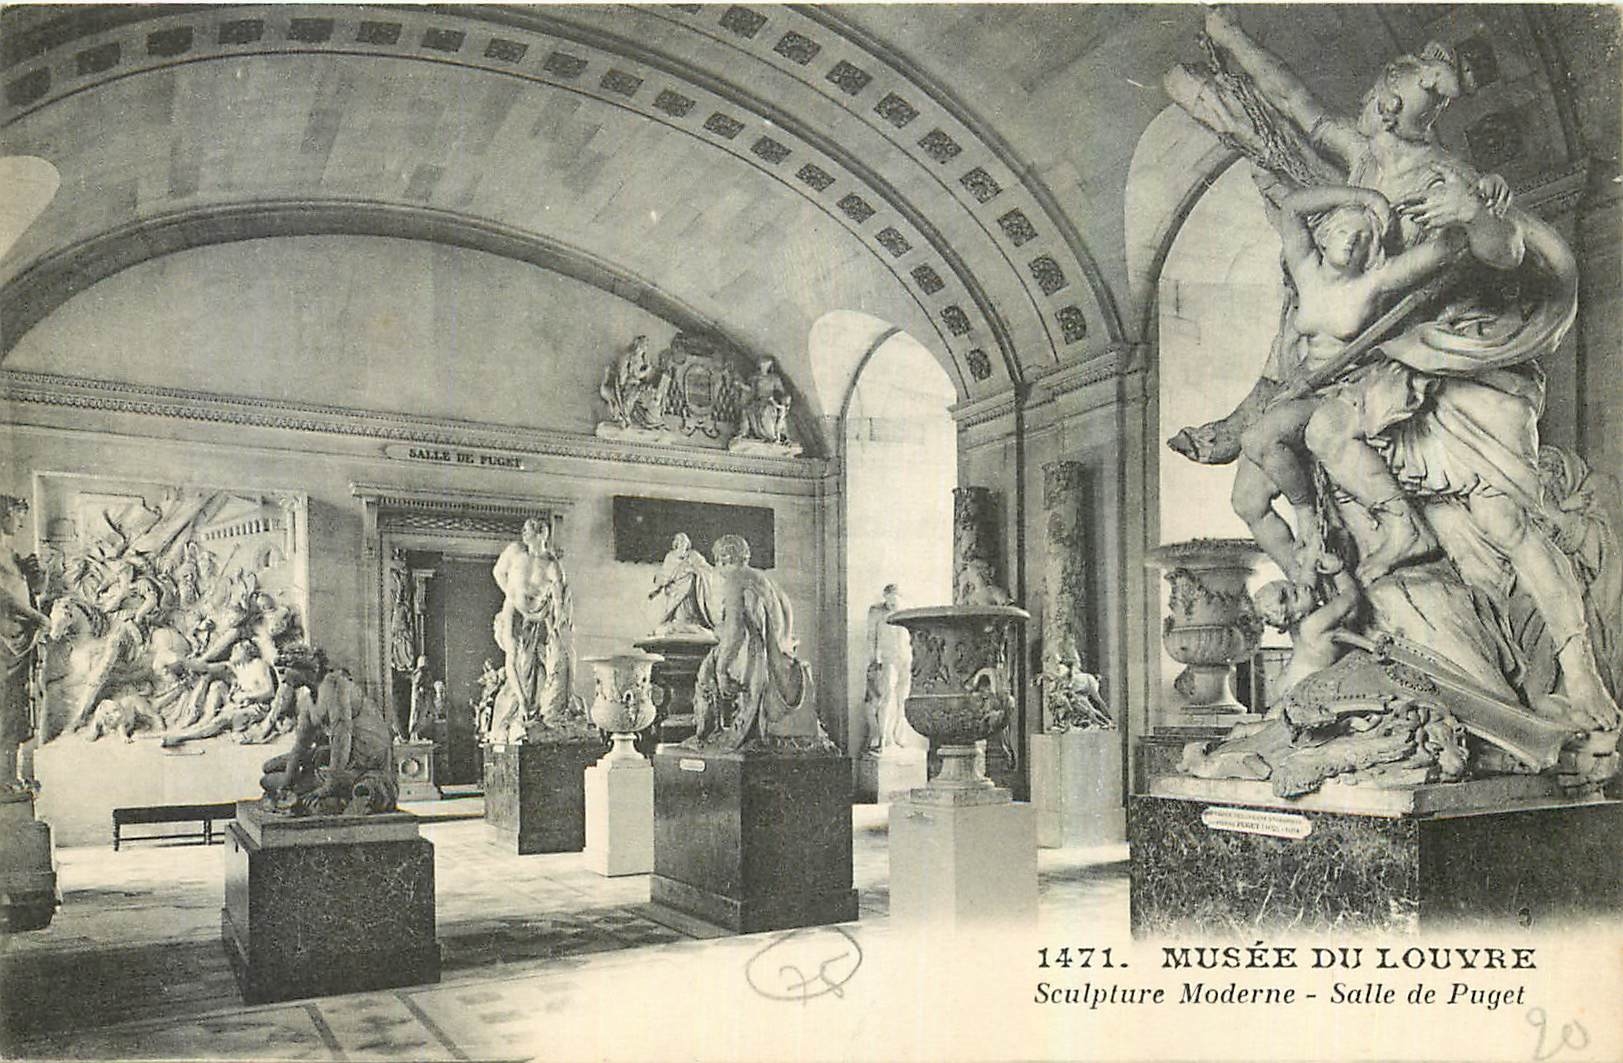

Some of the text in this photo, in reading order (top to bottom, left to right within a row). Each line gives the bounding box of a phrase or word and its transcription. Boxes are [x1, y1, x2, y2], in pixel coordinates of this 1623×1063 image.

[408, 448, 522, 468] SALLE DE PUGET
